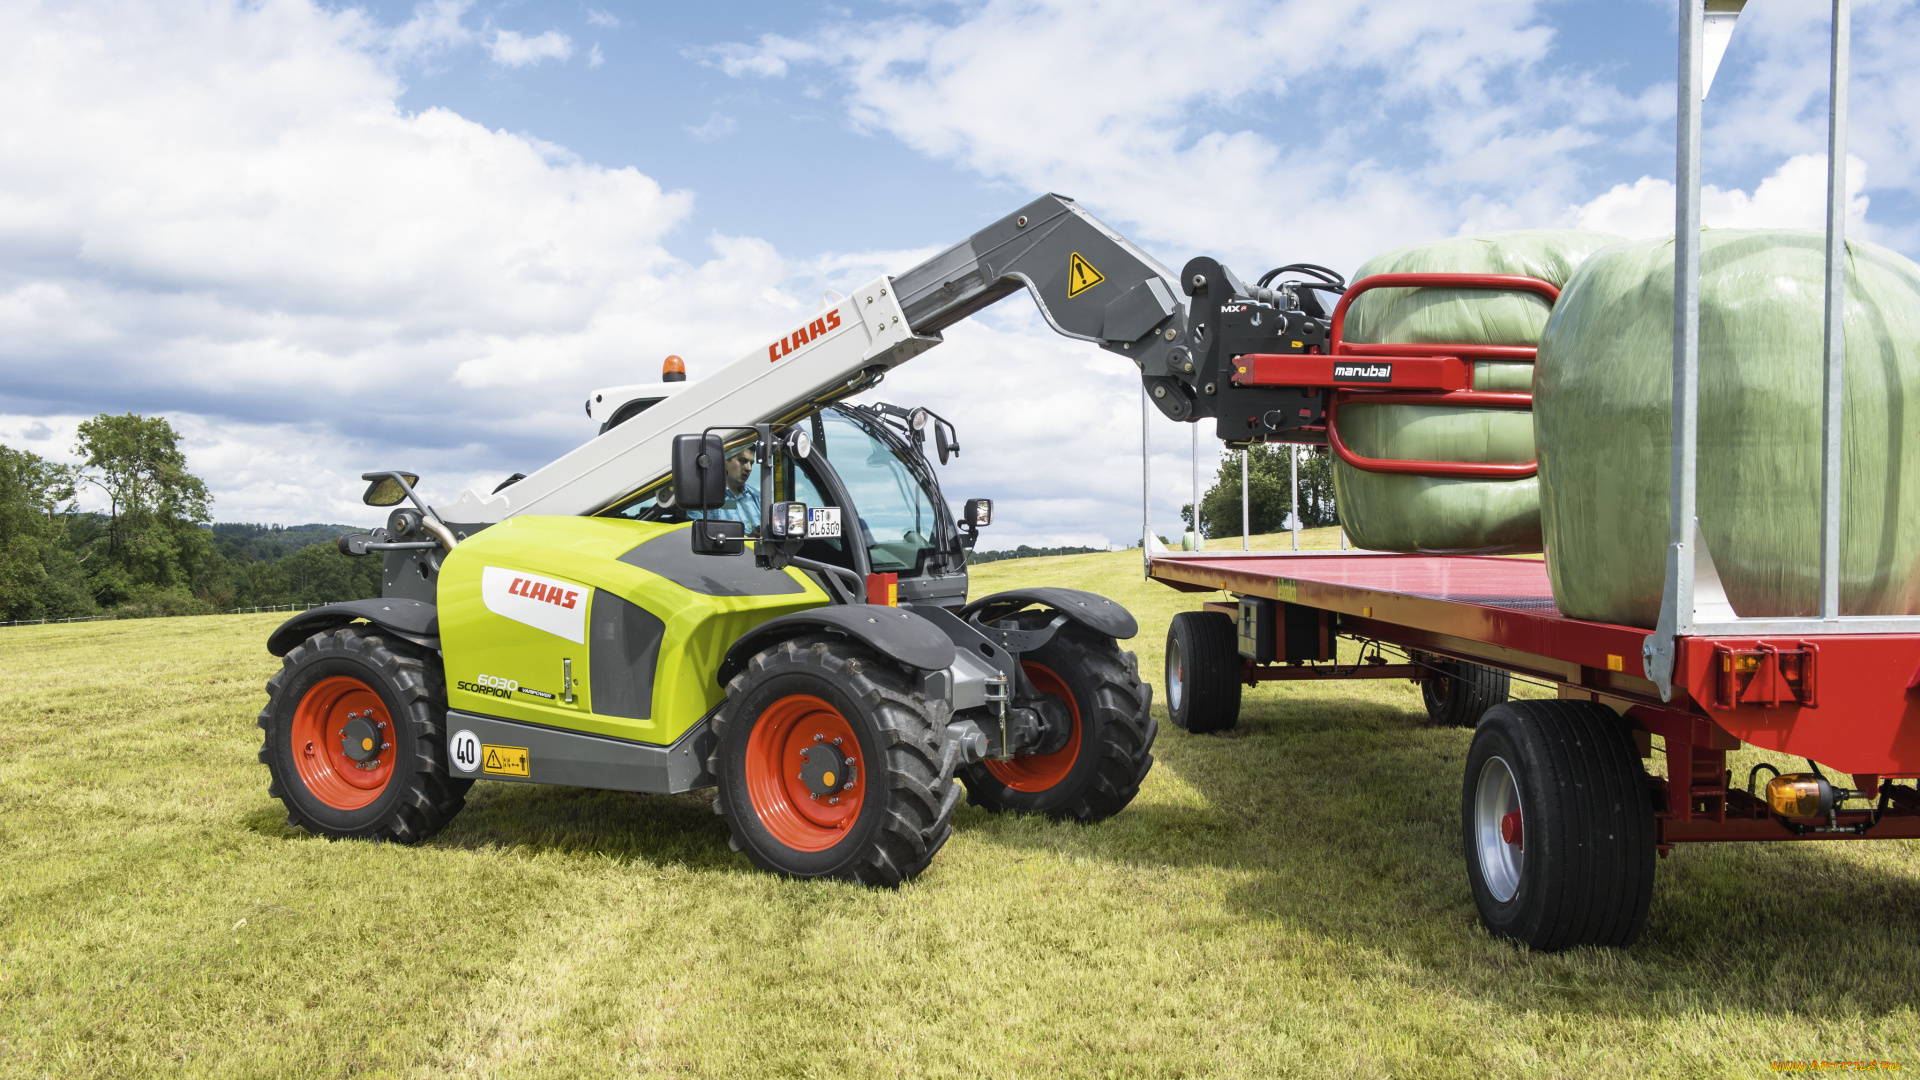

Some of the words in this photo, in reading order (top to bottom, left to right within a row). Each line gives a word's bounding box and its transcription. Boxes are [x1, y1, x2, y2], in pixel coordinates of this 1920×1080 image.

[769, 308, 841, 363] CLAAS
[1335, 364, 1391, 377] manubal
[815, 510, 825, 521] GT
[508, 577, 579, 609] CLAAS
[457, 681, 512, 699] SCORPION
[477, 674, 518, 691] 6030
[456, 738, 475, 764] 40
